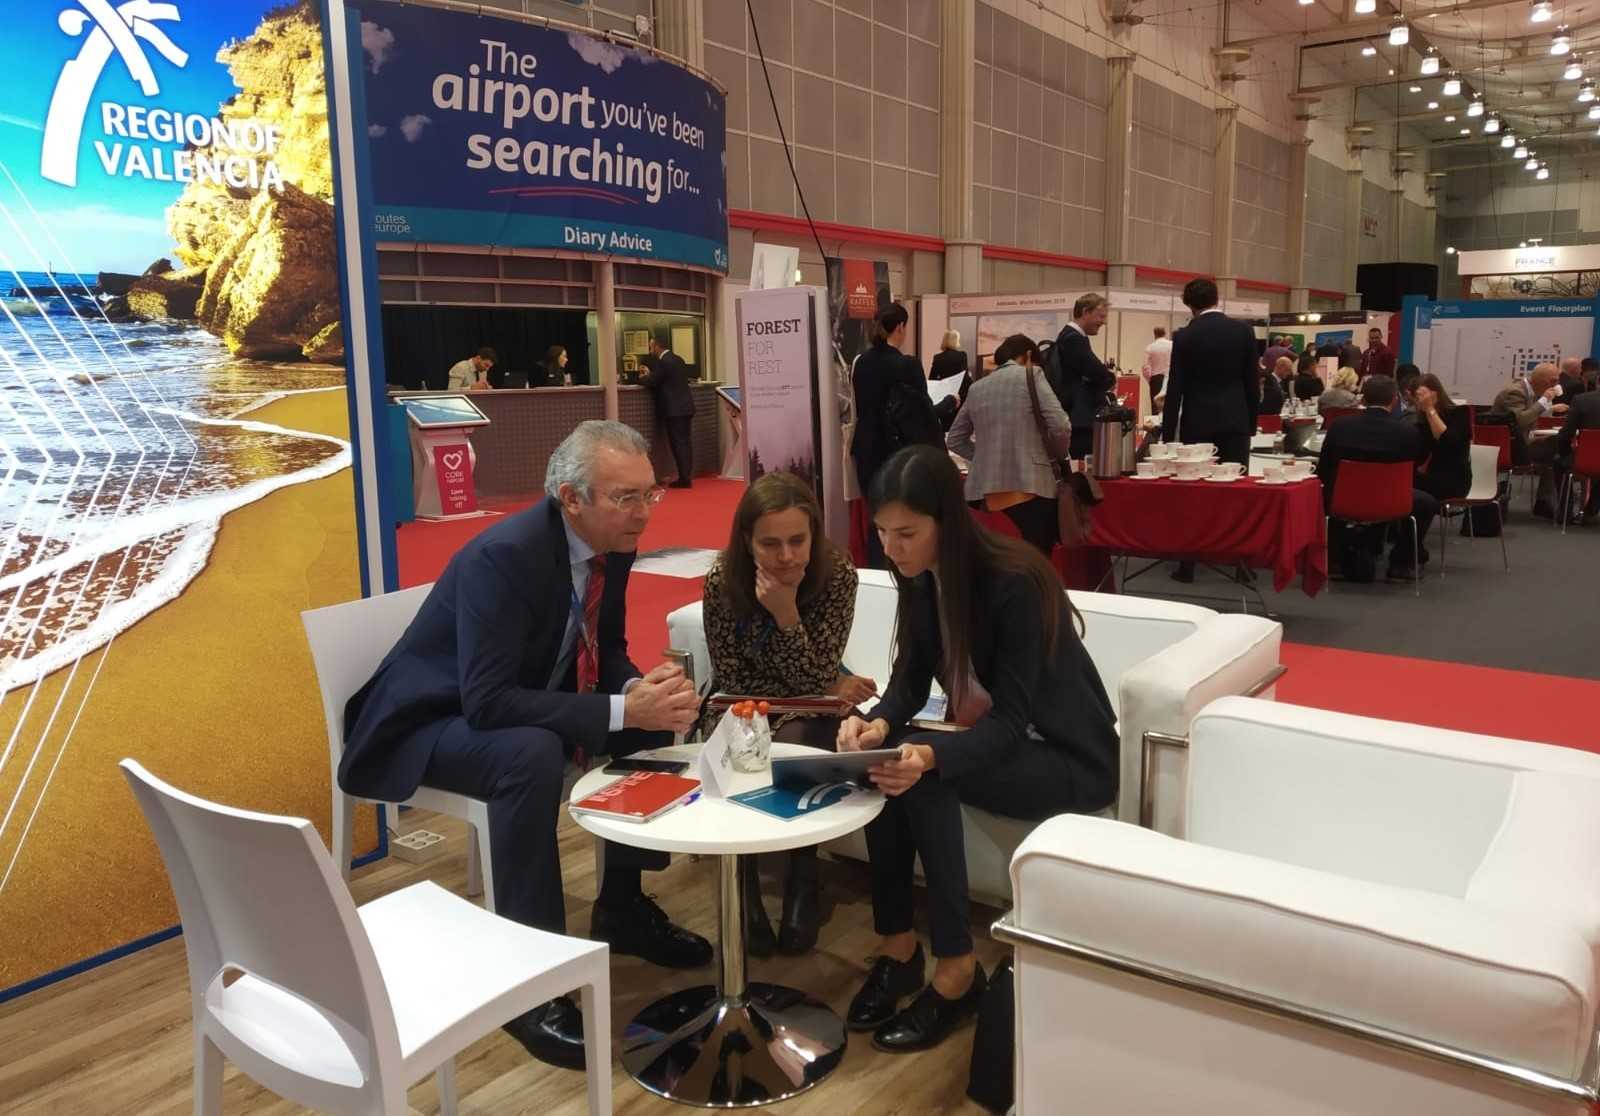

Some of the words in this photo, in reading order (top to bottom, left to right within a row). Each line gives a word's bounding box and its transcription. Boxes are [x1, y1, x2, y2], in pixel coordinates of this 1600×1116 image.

[480, 39, 537, 79] The
[432, 64, 596, 129] airport
[601, 99, 667, 137] you've
[673, 112, 705, 151] been
[101, 102, 240, 148] REGION
[241, 119, 282, 153] OF
[95, 141, 285, 193] VALENCIA
[466, 134, 663, 204] searching
[667, 159, 701, 196] for...
[564, 226, 606, 250] Diary
[610, 231, 653, 252] Advice
[1520, 305, 1546, 313] Event
[1548, 304, 1592, 314] Floorplan
[746, 318, 801, 336] FOREST
[748, 340, 775, 355] FOR
[748, 359, 784, 375] REST
